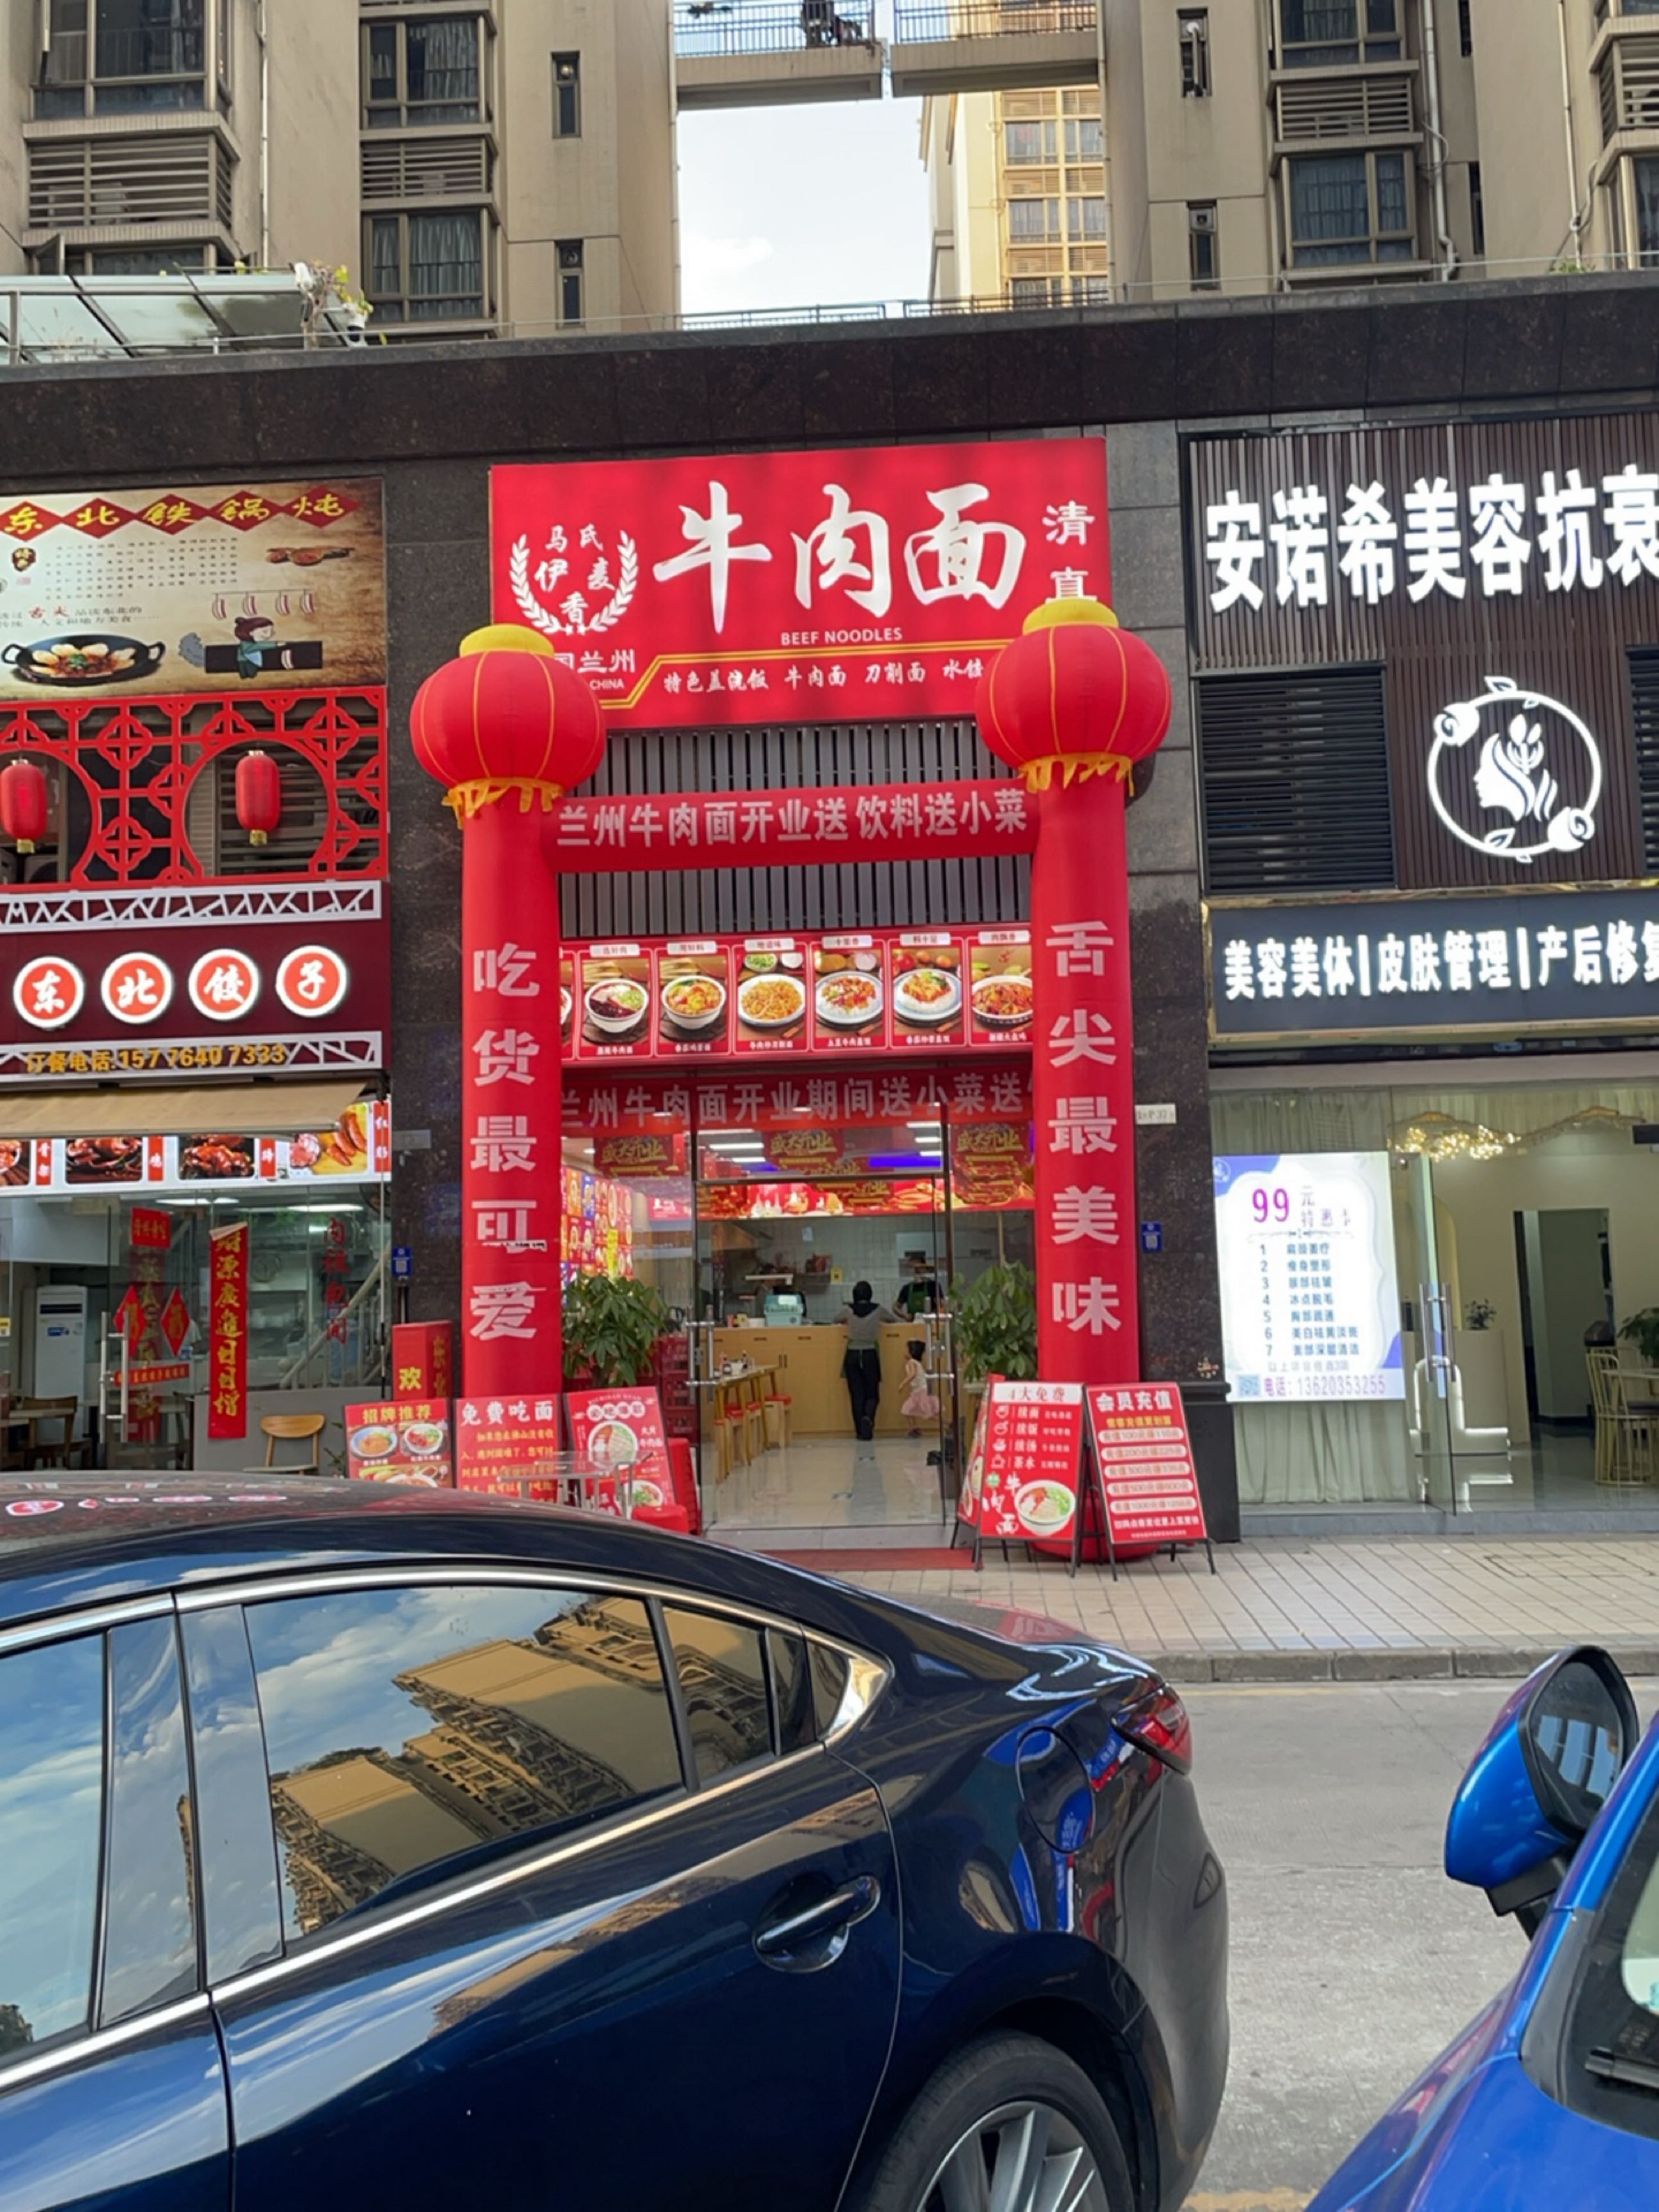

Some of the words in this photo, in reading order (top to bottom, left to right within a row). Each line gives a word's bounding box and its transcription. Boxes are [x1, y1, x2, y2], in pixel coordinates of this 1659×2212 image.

[545, 523, 604, 553] 马氏
[1042, 500, 1098, 604] 清真
[1206, 464, 1659, 613] 安诺希美容抗衰
[653, 479, 1027, 634] 牛肉面
[780, 631, 819, 646] BEEF
[824, 627, 902, 644] NOODLES
[589, 678, 625, 691] CHINA
[784, 664, 847, 691] 牛肉面
[865, 661, 926, 684] 刀削面
[31, 961, 326, 1014] 东北饺子
[228, 1042, 287, 1065] 7333
[561, 1073, 1034, 1129] 兰州牛肉面开业期间送小菜送
[470, 943, 547, 1341] 吃货最可爱
[1046, 920, 1121, 1335] 舌尖最美味
[1252, 1188, 1290, 1224] 99
[398, 1366, 421, 1391] 欢
[363, 1404, 431, 1424] 招牌推荐
[1096, 1390, 1173, 1413] 会员充值
